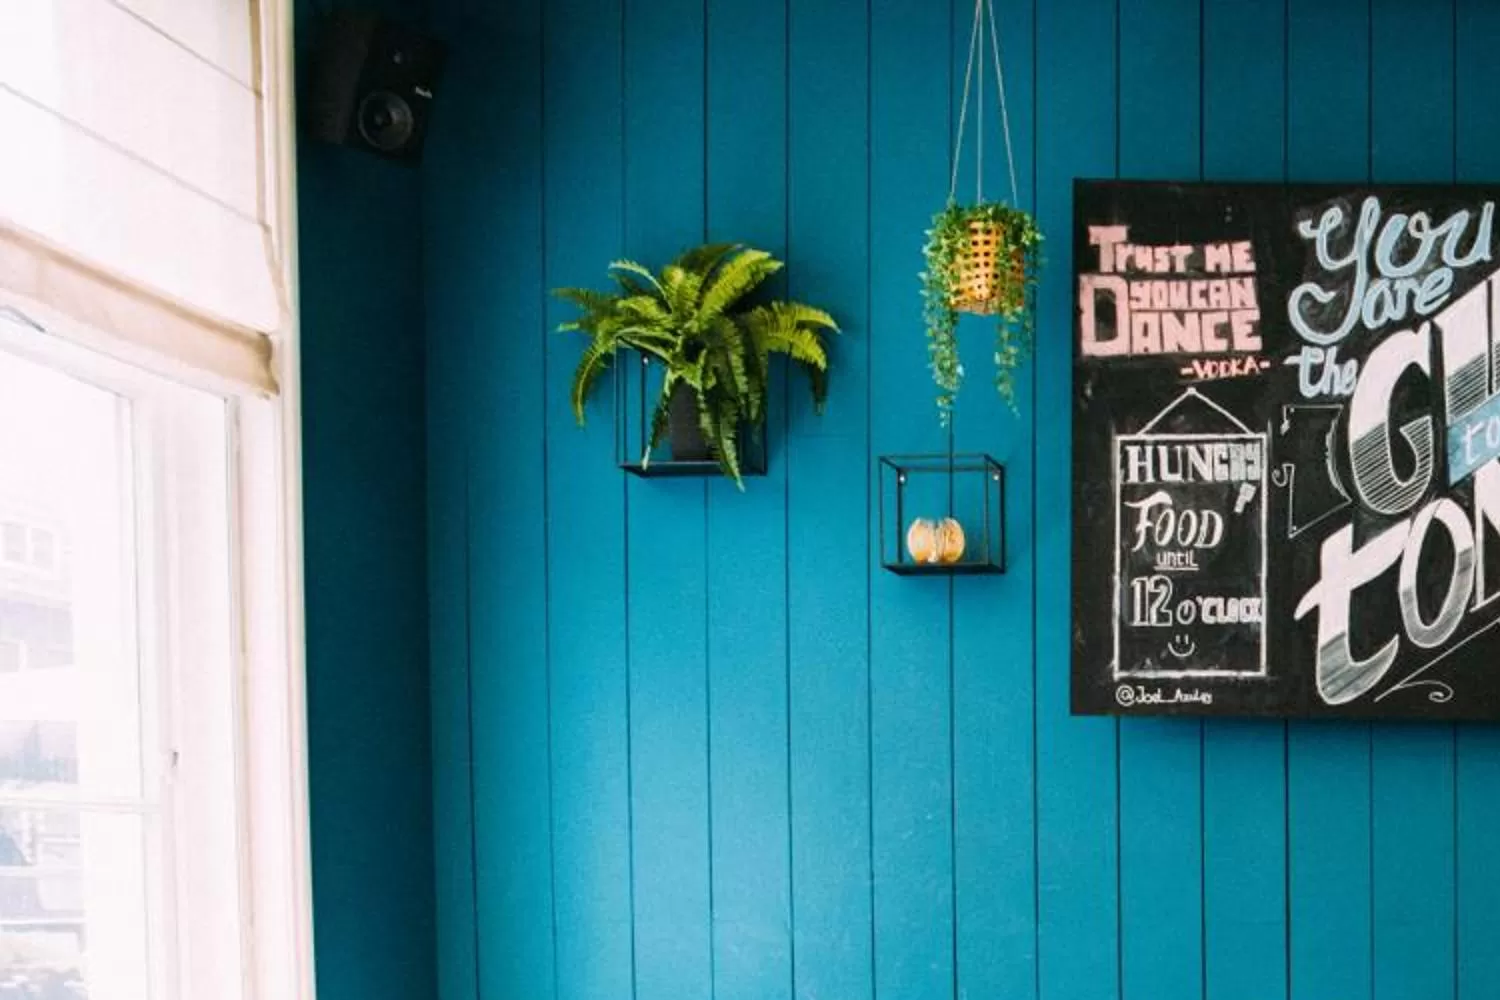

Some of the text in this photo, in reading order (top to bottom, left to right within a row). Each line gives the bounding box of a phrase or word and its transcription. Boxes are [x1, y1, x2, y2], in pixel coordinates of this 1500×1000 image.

[1204, 240, 1256, 273] ME
[1288, 195, 1496, 345] You
[1079, 273, 1263, 357] DANCE
[1362, 266, 1454, 330] are
[1284, 345, 1357, 399] the
[1124, 491, 1224, 552] FOOD
[1130, 574, 1173, 627] 12
